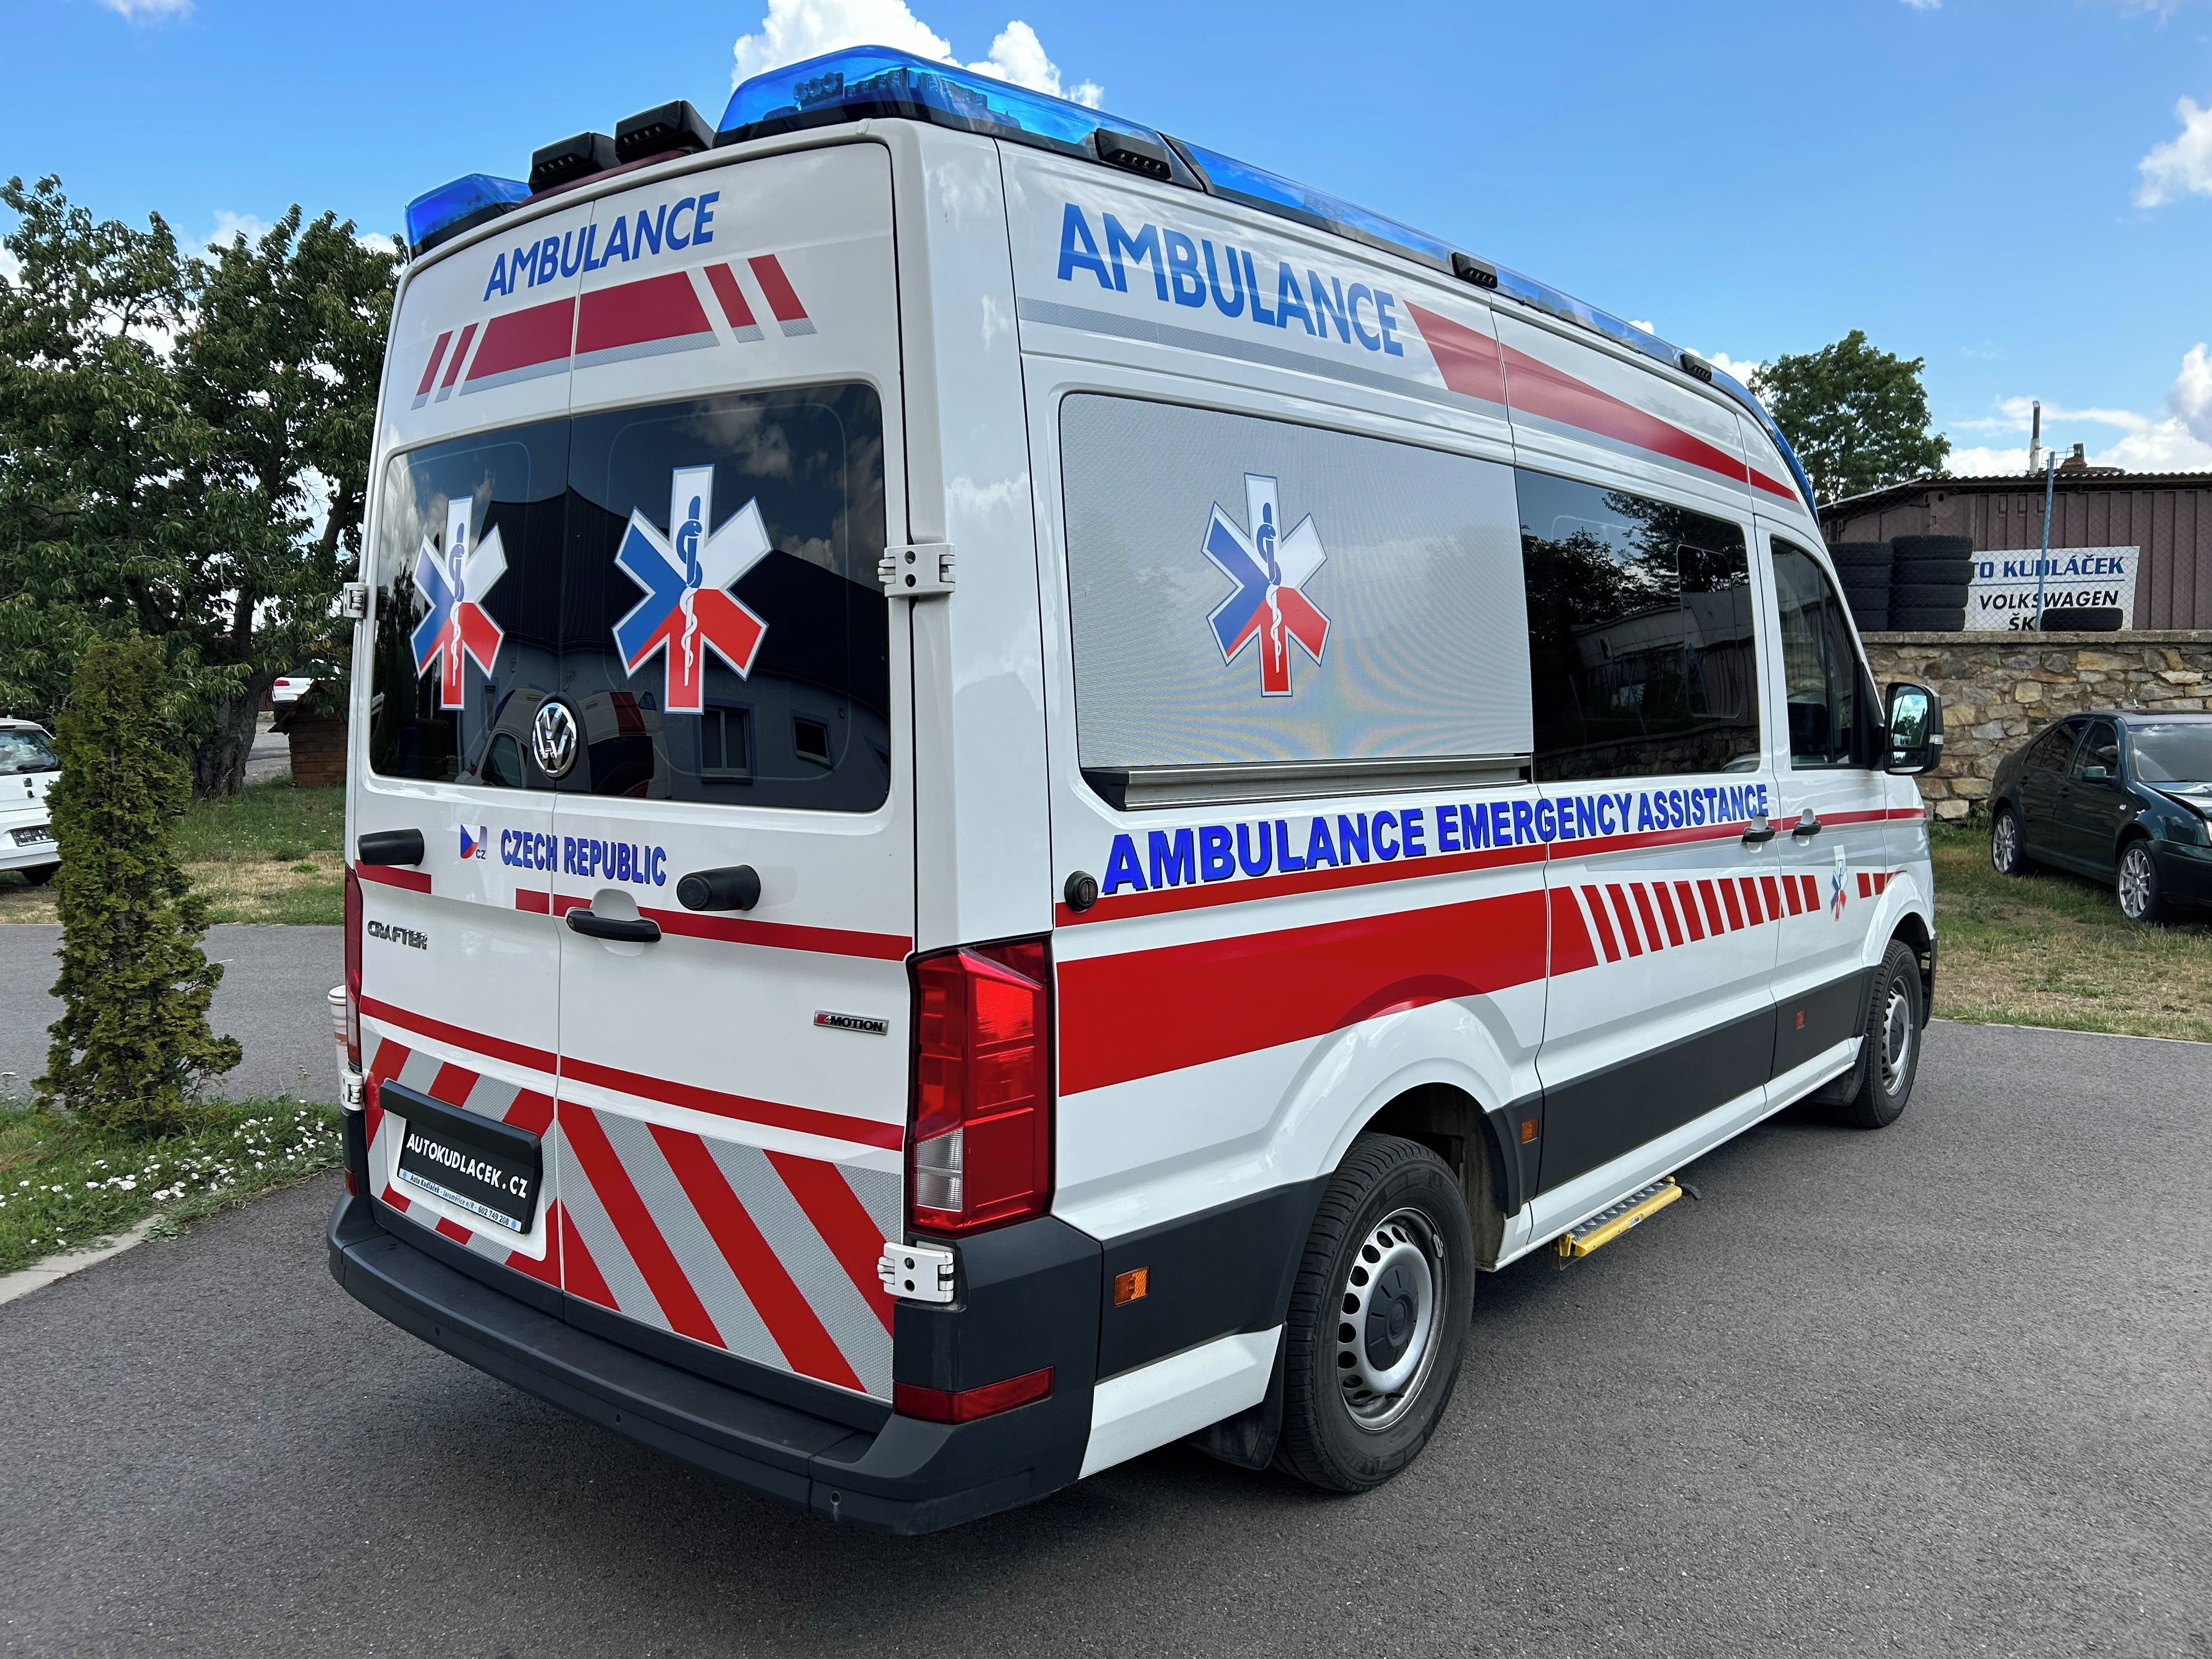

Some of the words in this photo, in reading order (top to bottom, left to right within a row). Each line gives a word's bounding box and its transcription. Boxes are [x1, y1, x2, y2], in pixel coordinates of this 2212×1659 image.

[483, 191, 720, 301] AMBULANCE
[1057, 202, 1404, 357] AMBULANCE
[2003, 554, 2124, 578] KUDLÁČEK
[1979, 590, 2119, 610] VOLKSWAGEN
[476, 849, 486, 860] CZ
[1101, 808, 1426, 895] AMBULANCE
[1436, 793, 1632, 853] EMERGENCY
[1638, 784, 1769, 832] ASSISTANCE
[500, 829, 557, 872] CZECH
[563, 836, 667, 887] REPUBLIC
[368, 920, 428, 950] CRAFTER
[478, 1205, 488, 1216] 602
[489, 1210, 499, 1221] 749
[499, 1215, 509, 1226] 208
